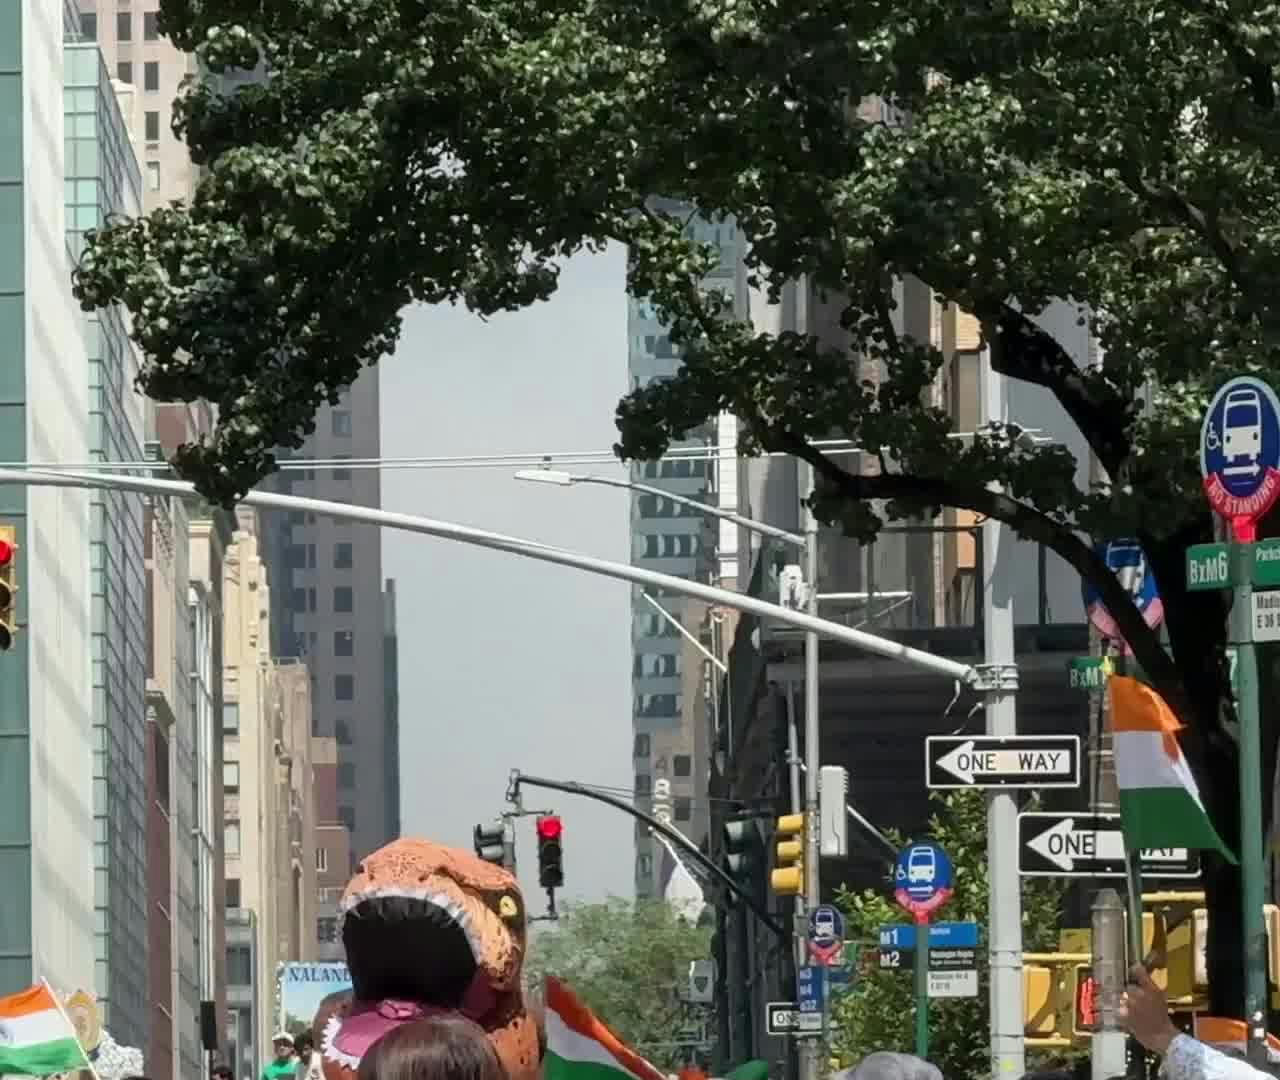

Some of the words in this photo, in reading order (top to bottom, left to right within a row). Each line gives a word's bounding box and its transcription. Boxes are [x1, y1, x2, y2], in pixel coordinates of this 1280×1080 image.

[1208, 480, 1224, 505] NO
[1224, 475, 1276, 514] STANDING
[1190, 551, 1228, 585] BxM6
[957, 752, 997, 773] ONE
[1018, 751, 1061, 772] WAY
[1047, 833, 1095, 857] ONE
[880, 929, 898, 945] M1
[880, 951, 900, 967] M2
[288, 967, 353, 982] NALAND
